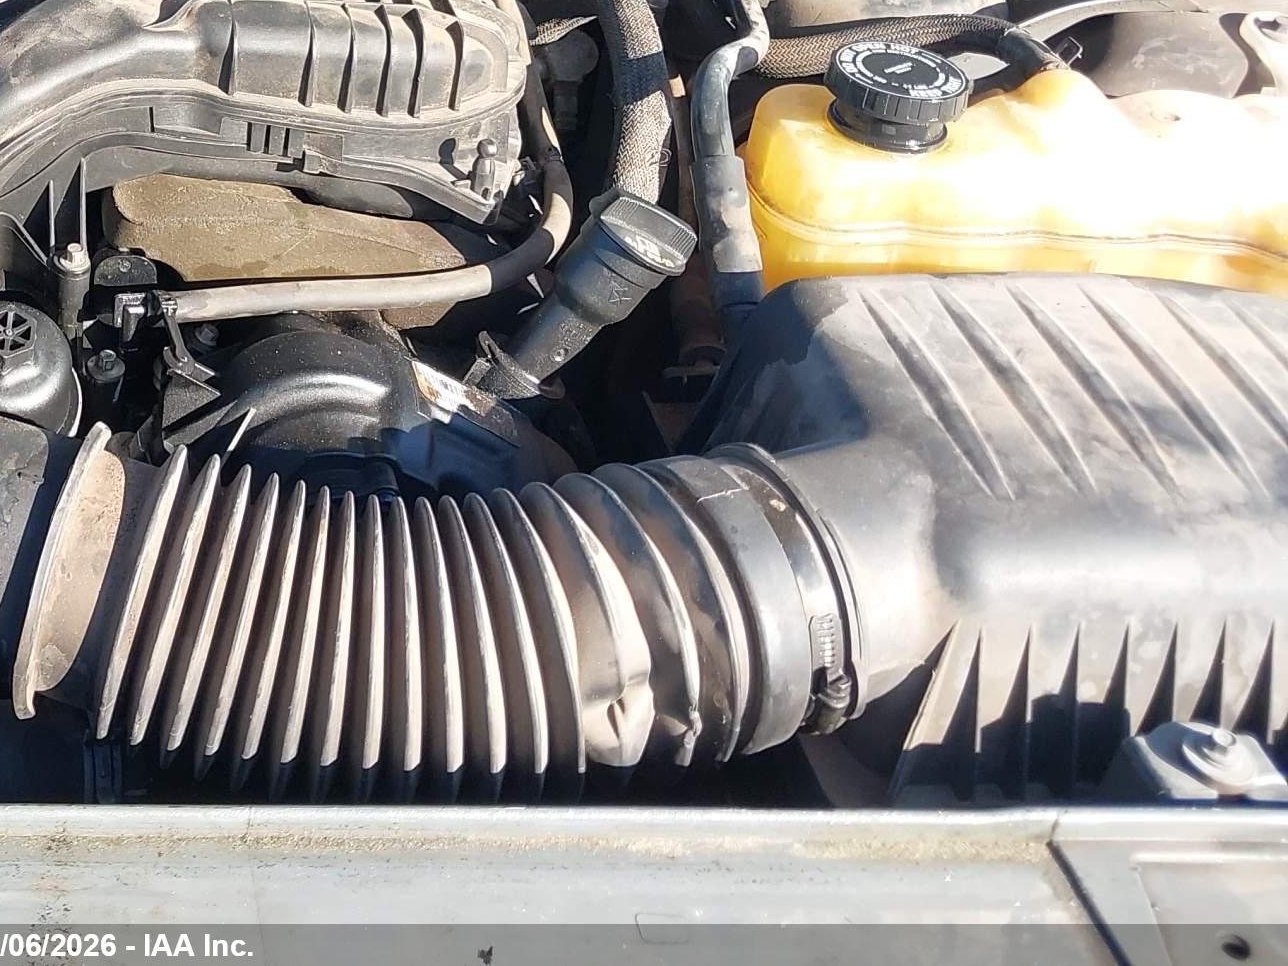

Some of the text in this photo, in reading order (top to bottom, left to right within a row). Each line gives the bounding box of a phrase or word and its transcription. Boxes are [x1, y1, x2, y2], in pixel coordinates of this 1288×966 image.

[851, 42, 886, 52] OPEN
[890, 42, 920, 54] HOT
[908, 88, 943, 98] KEEP
